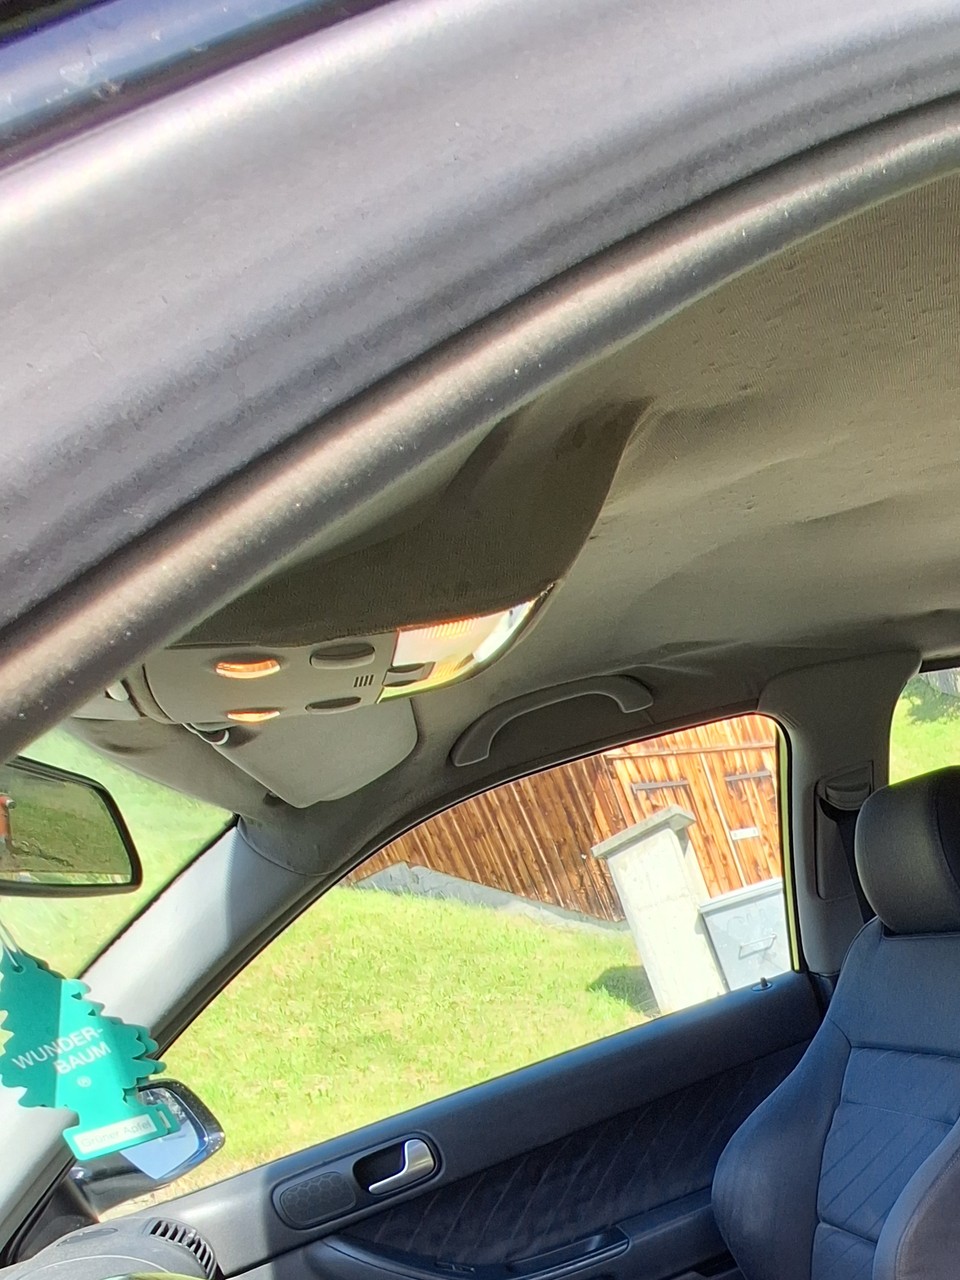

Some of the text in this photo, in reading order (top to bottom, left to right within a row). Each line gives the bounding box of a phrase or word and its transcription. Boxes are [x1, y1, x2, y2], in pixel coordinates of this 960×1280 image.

[12, 1027, 103, 1069] WUNDER-
[53, 1041, 111, 1074] BAUM
[124, 1119, 152, 1134] Apfel
